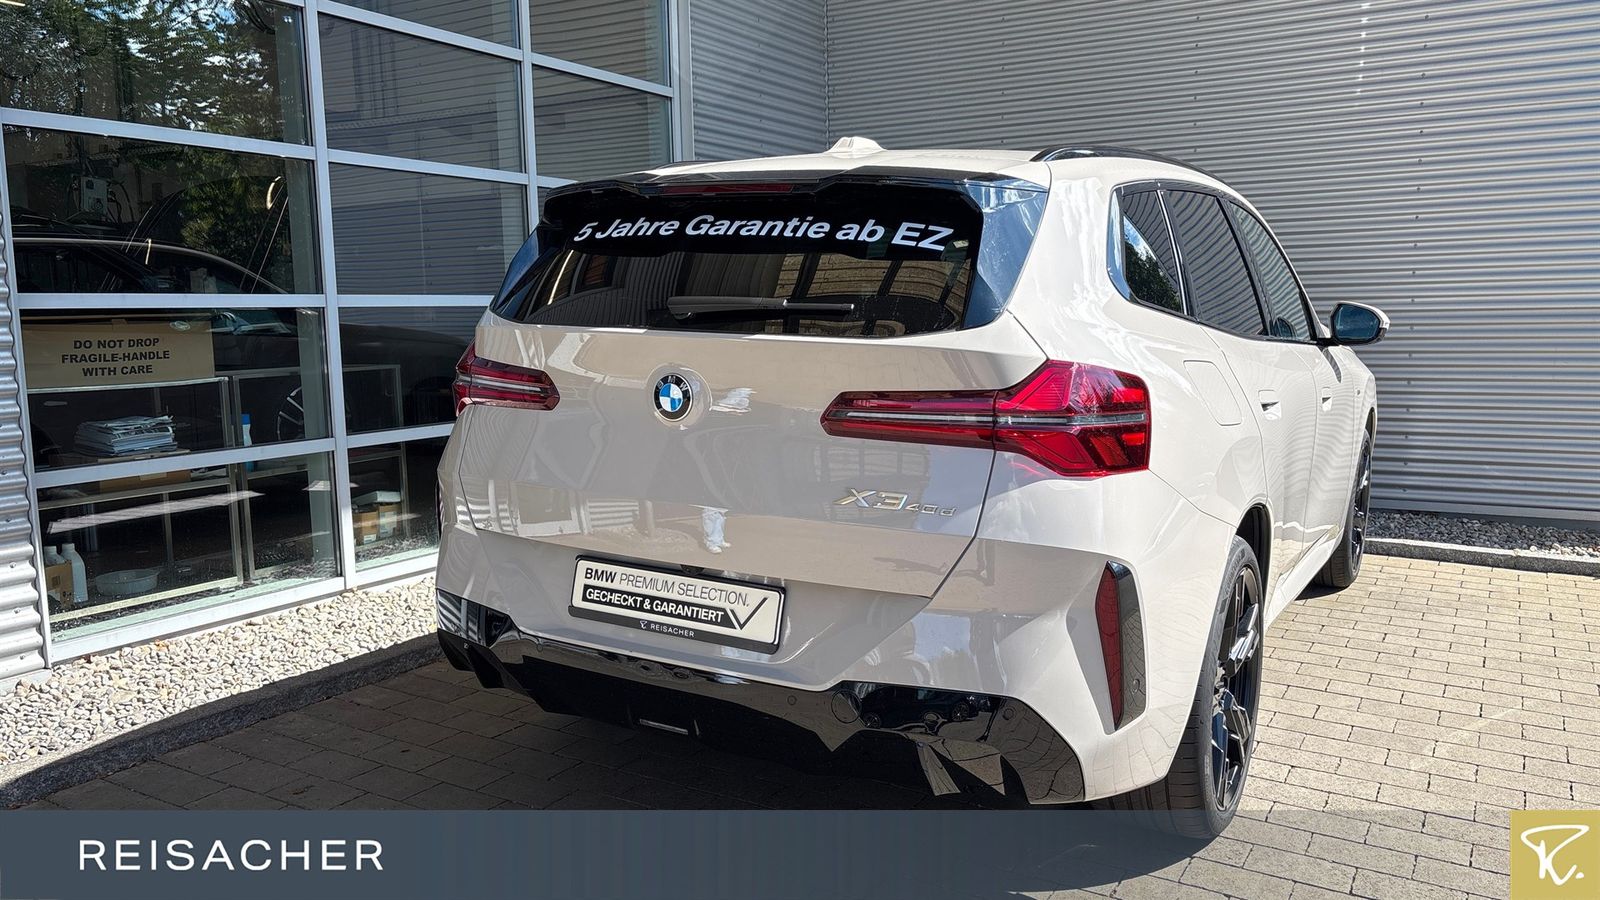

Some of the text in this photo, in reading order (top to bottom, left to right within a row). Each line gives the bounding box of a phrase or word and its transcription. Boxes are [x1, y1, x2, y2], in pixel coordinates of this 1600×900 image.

[573, 214, 954, 252] 5 Jahre Garantie ab EZ
[73, 337, 160, 350] DO NOT DROP
[61, 350, 170, 364] FRAGILE-HANDLE
[82, 364, 153, 377] WITH CARE
[833, 488, 908, 510] X3
[584, 567, 750, 608] BMW PREMIUM SELECTION.
[585, 587, 725, 624] GECHECKT & GARANTIERT
[650, 622, 695, 638] REISACHER
